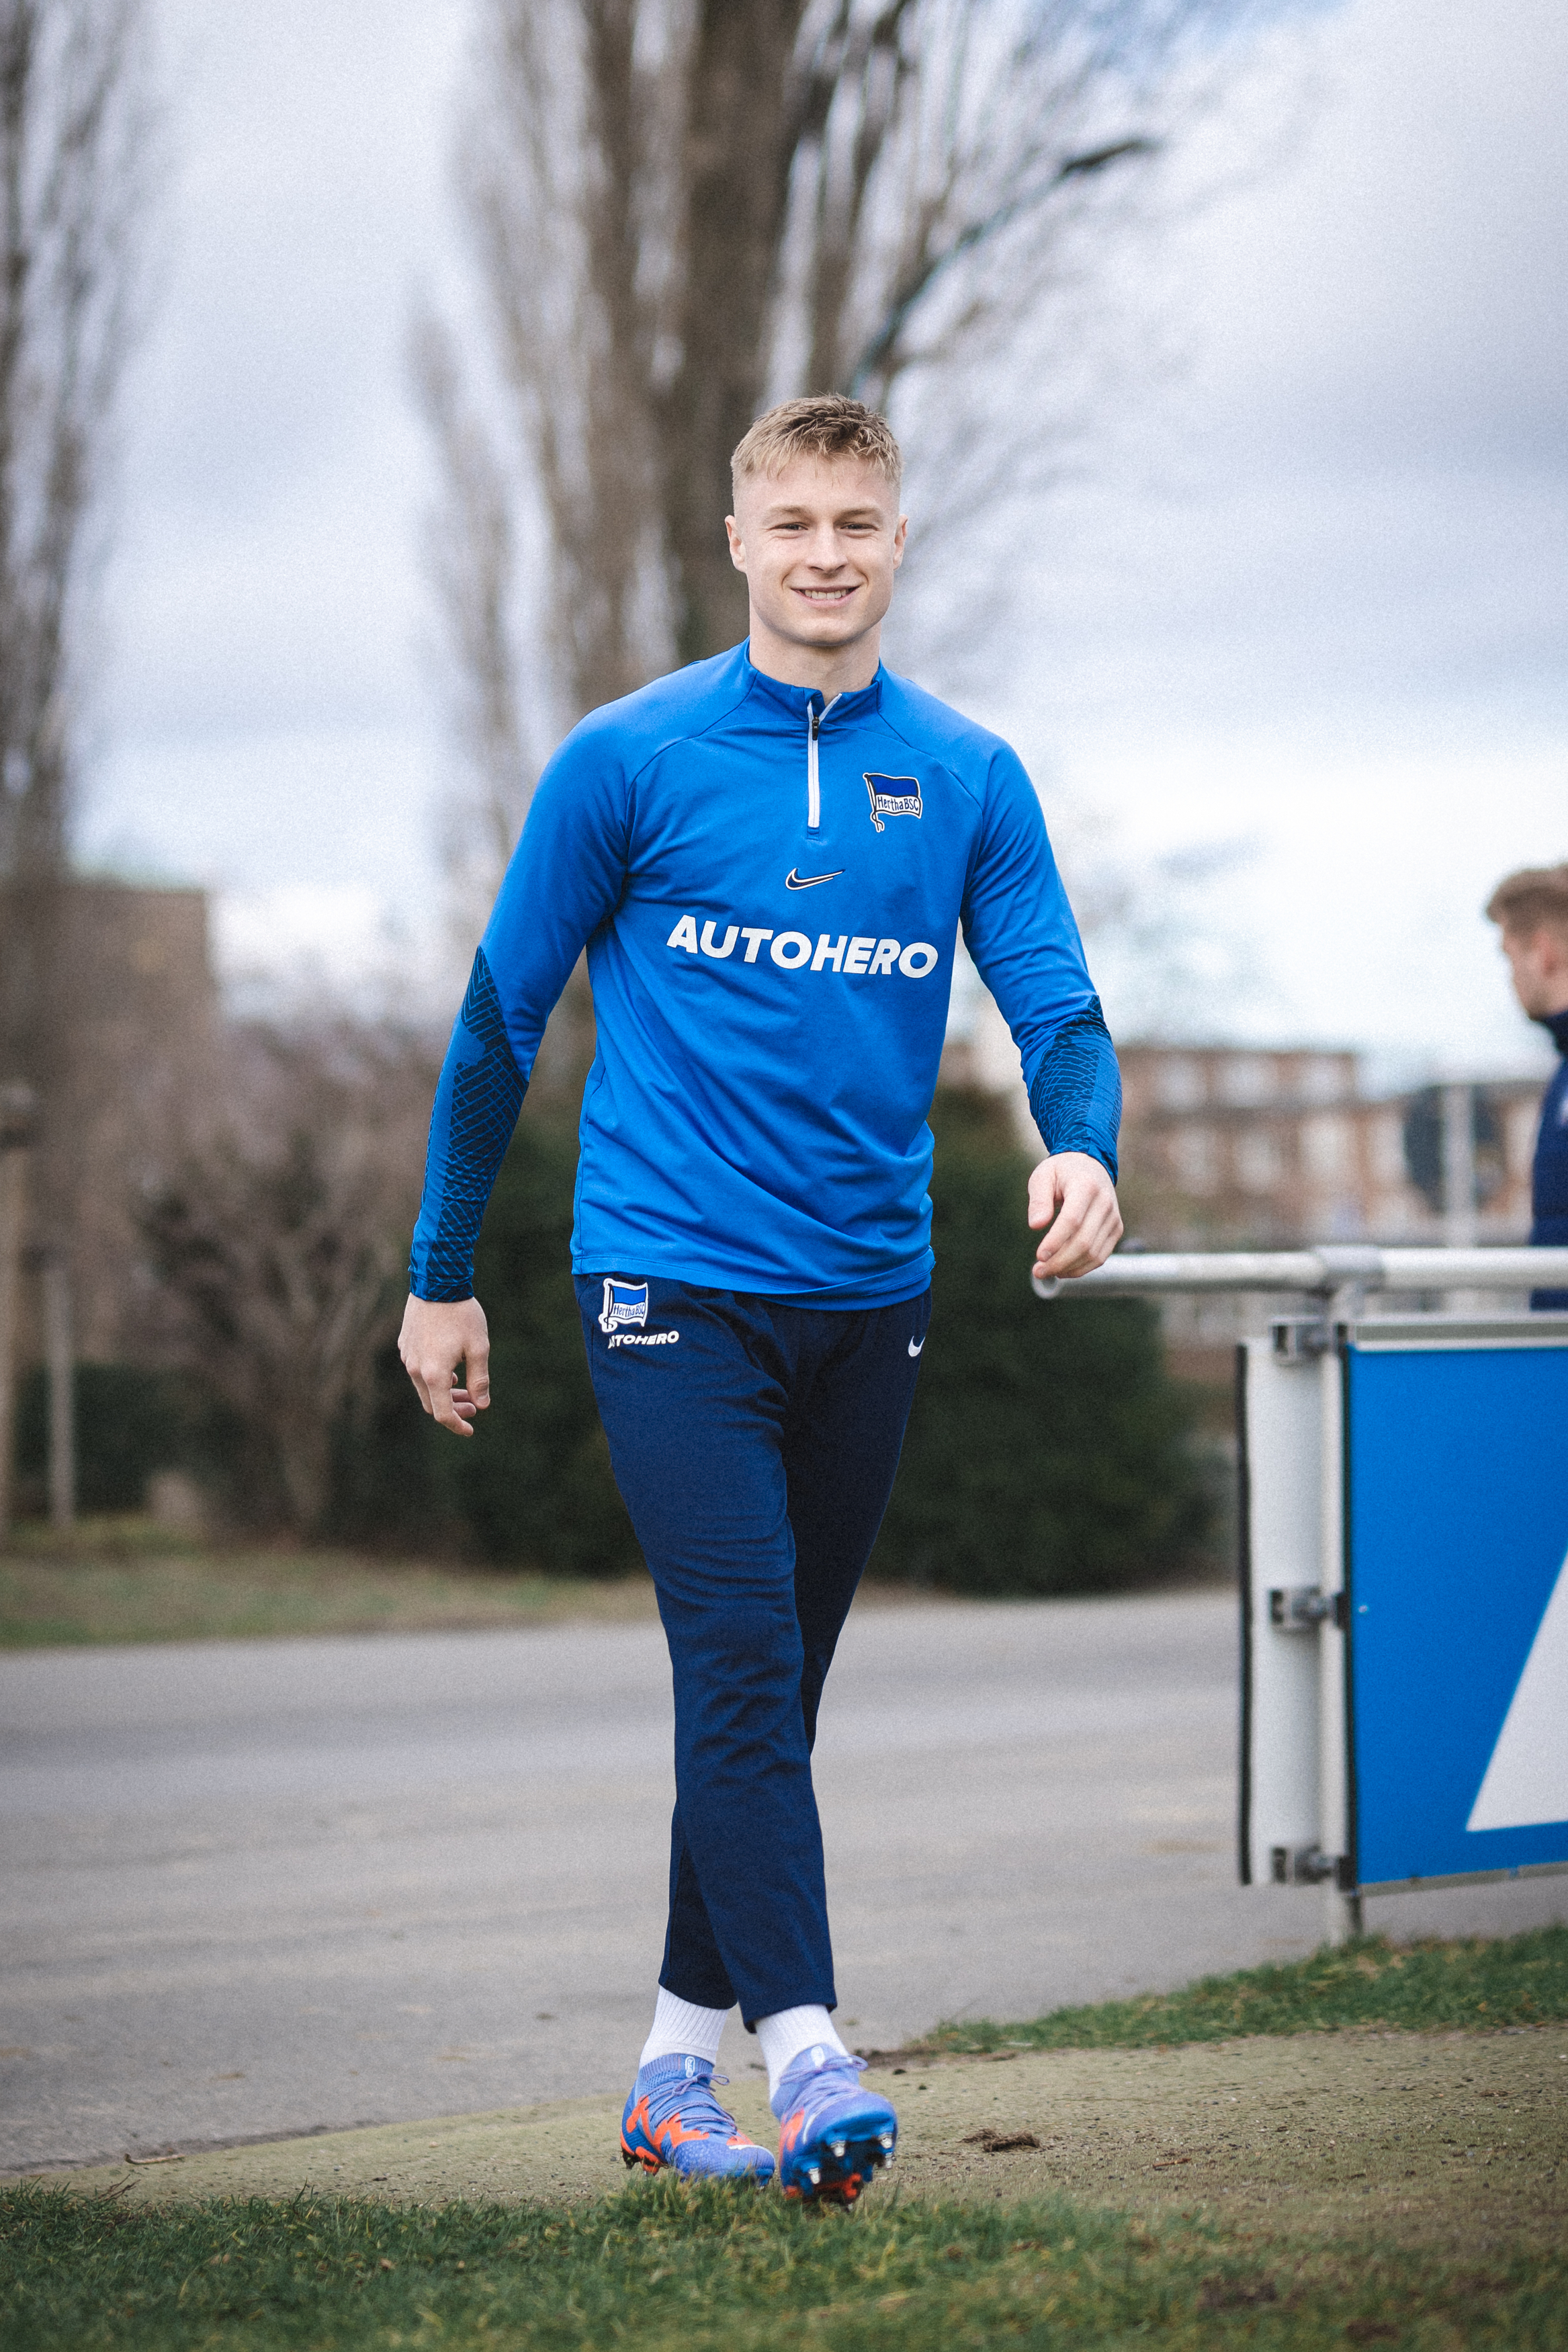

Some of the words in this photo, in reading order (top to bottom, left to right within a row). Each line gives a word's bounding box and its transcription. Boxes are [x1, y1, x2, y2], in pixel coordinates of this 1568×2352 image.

[877, 796, 904, 811] Hertha
[904, 798, 919, 811] BSC
[666, 914, 939, 978] AUTOHERO
[613, 1304, 635, 1317] Hertha
[635, 1304, 646, 1317] BSC
[607, 1331, 680, 1349] TOHERO
